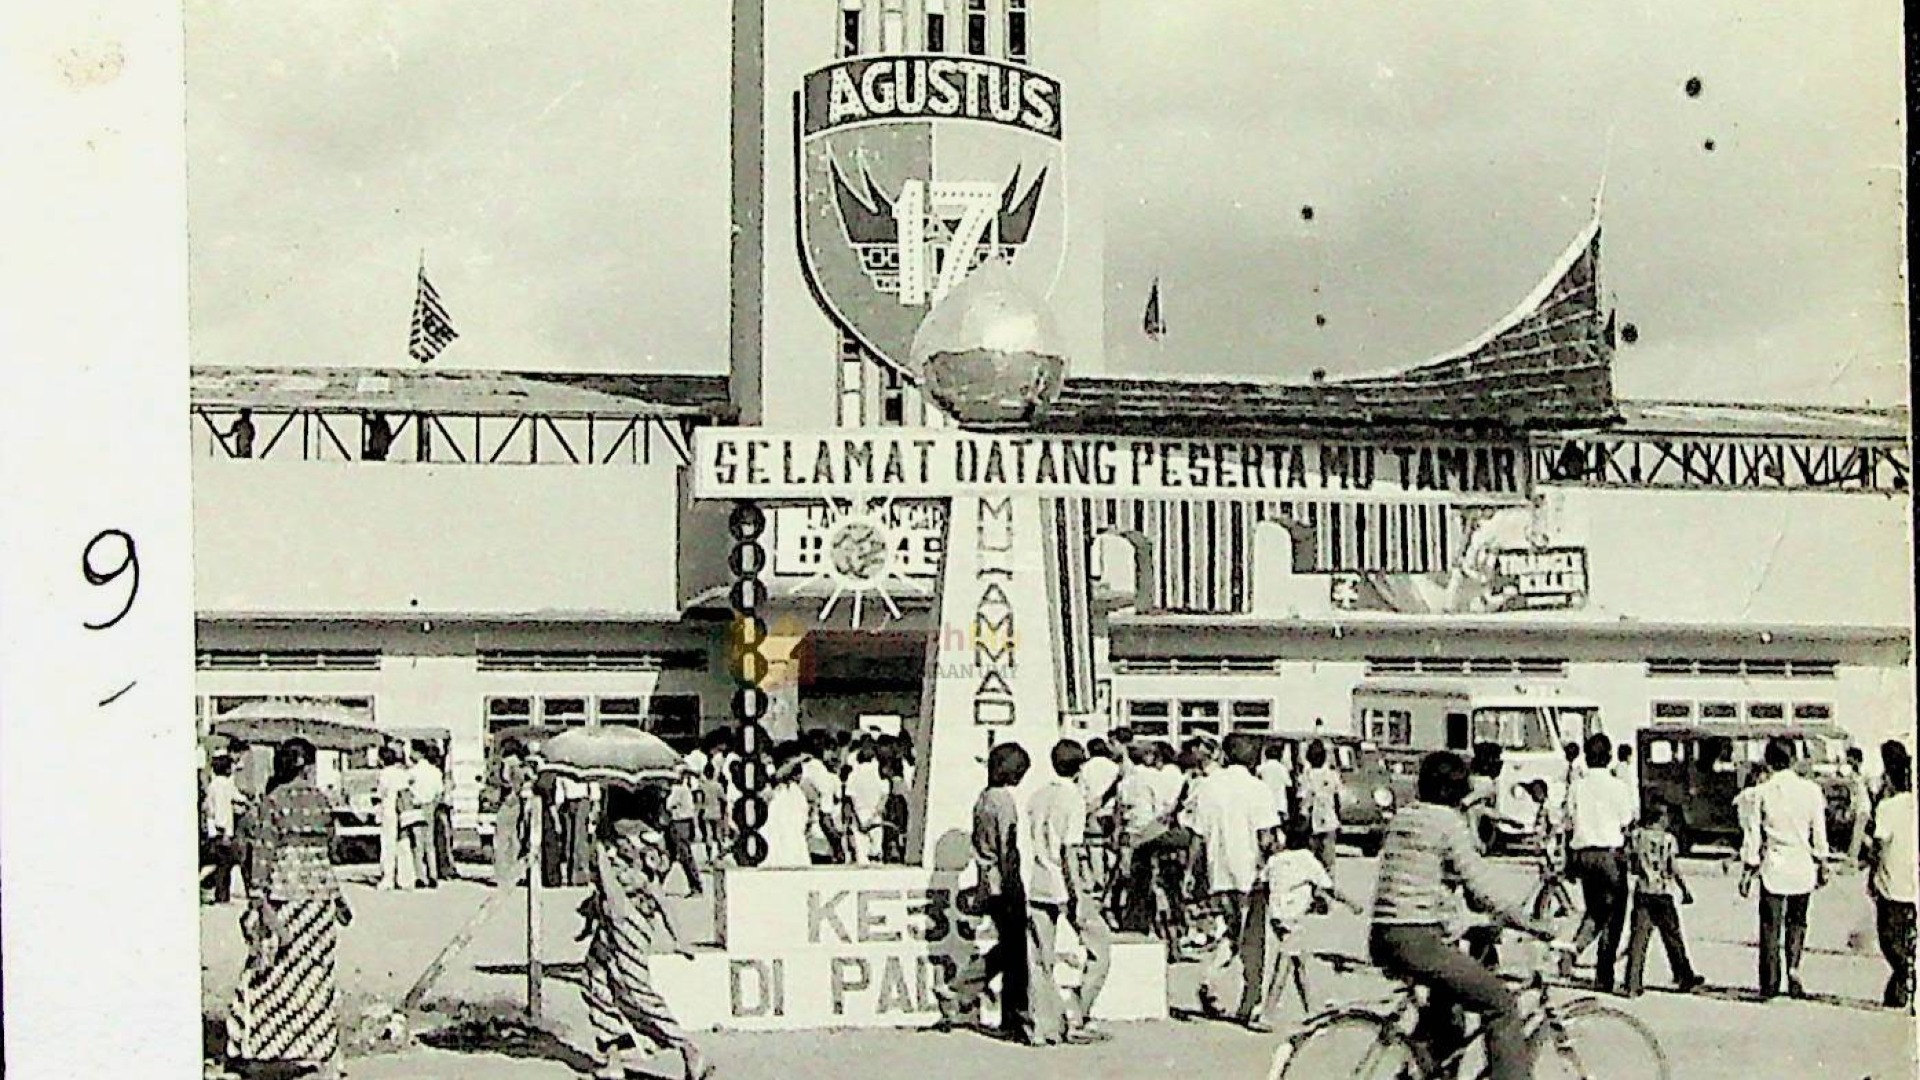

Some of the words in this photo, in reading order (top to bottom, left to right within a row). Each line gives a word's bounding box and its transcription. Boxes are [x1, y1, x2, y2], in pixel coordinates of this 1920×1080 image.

[827, 58, 1056, 131] AGUSTUS
[890, 176, 1002, 306] 17
[713, 440, 936, 485] SELAMAT
[955, 440, 1118, 485] DATANG
[1130, 442, 1308, 488] PESERTA
[82, 528, 140, 630] 9
[730, 958, 785, 1018] DI
